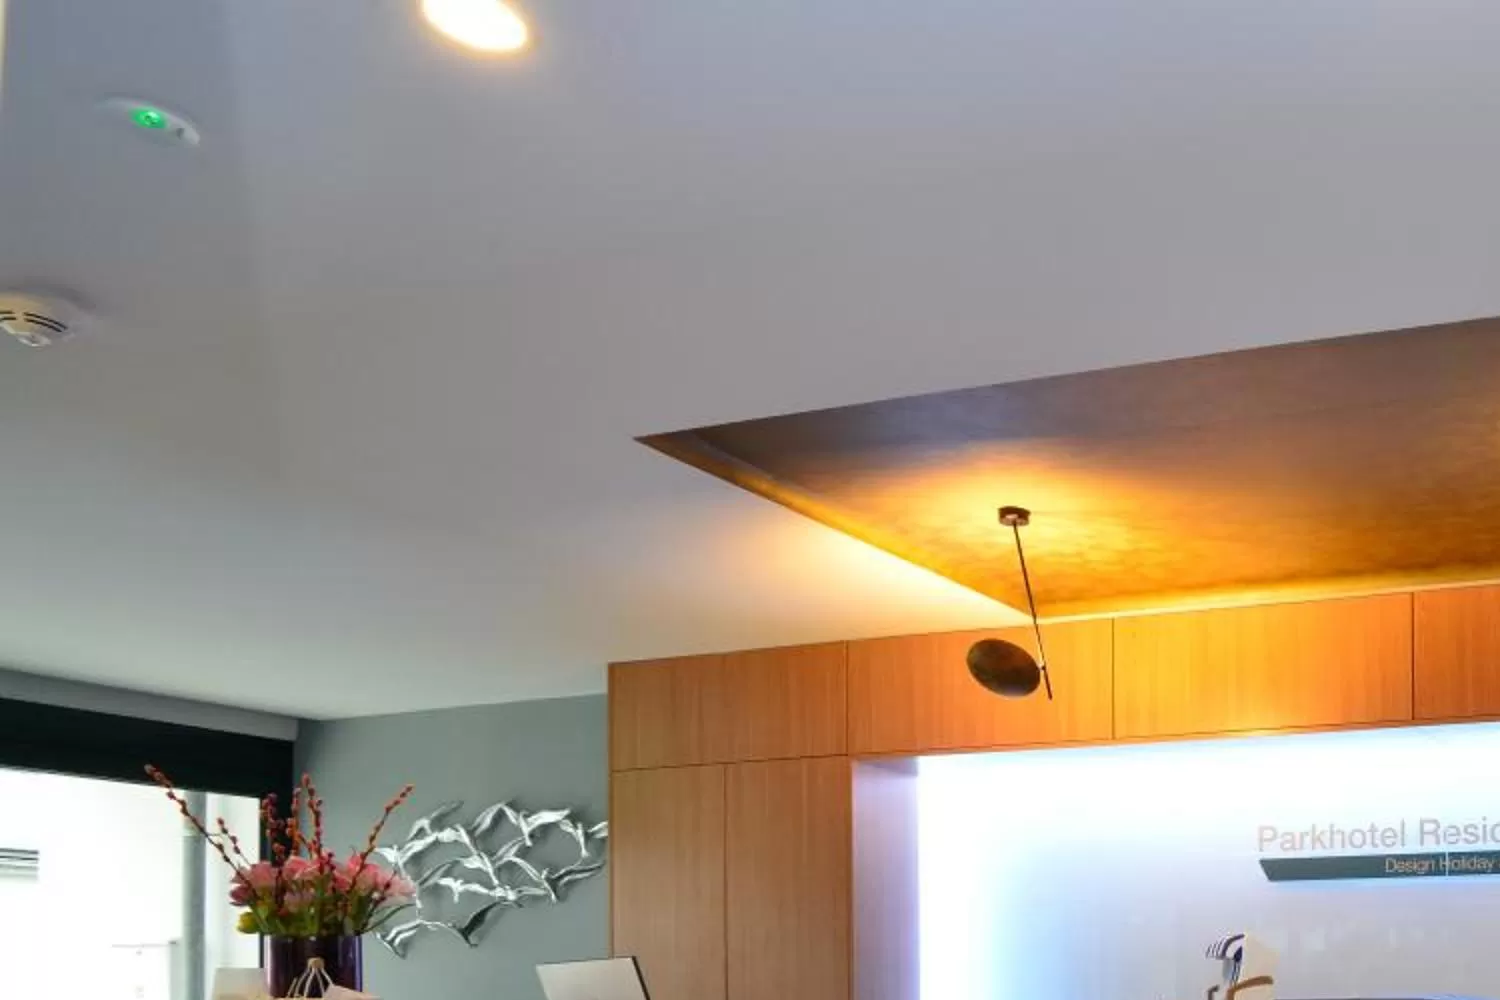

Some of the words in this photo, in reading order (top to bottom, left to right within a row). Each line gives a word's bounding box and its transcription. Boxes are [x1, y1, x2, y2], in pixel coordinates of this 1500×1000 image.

[1257, 818, 1406, 852] Parkhotel
[1384, 857, 1436, 875] Design
[1439, 854, 1495, 873] Holiday
